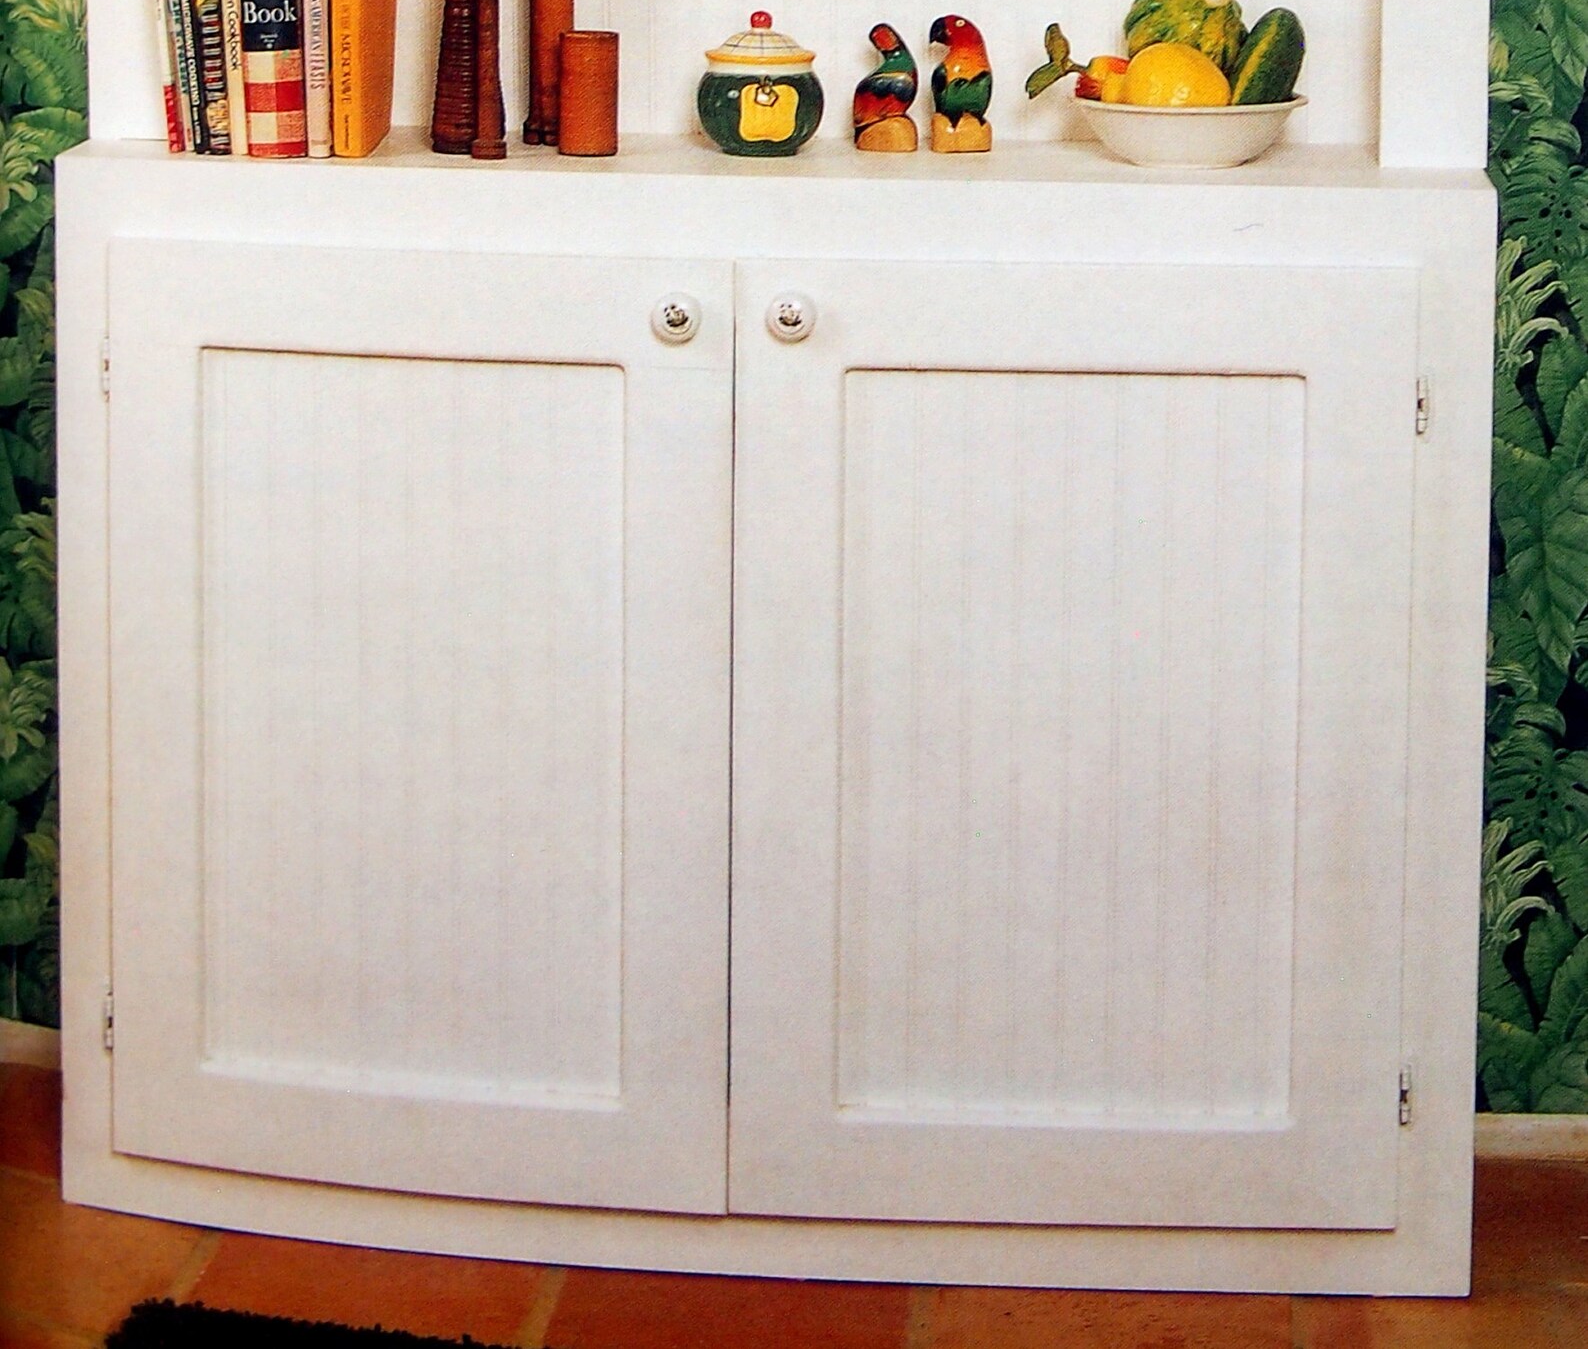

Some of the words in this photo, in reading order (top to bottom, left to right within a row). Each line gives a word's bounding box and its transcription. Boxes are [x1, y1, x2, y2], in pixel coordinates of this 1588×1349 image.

[242, 0, 297, 25] Book
[227, 11, 241, 70] Cookbook
[188, 58, 201, 106] COOKING
[309, 53, 326, 89] FEASTS
